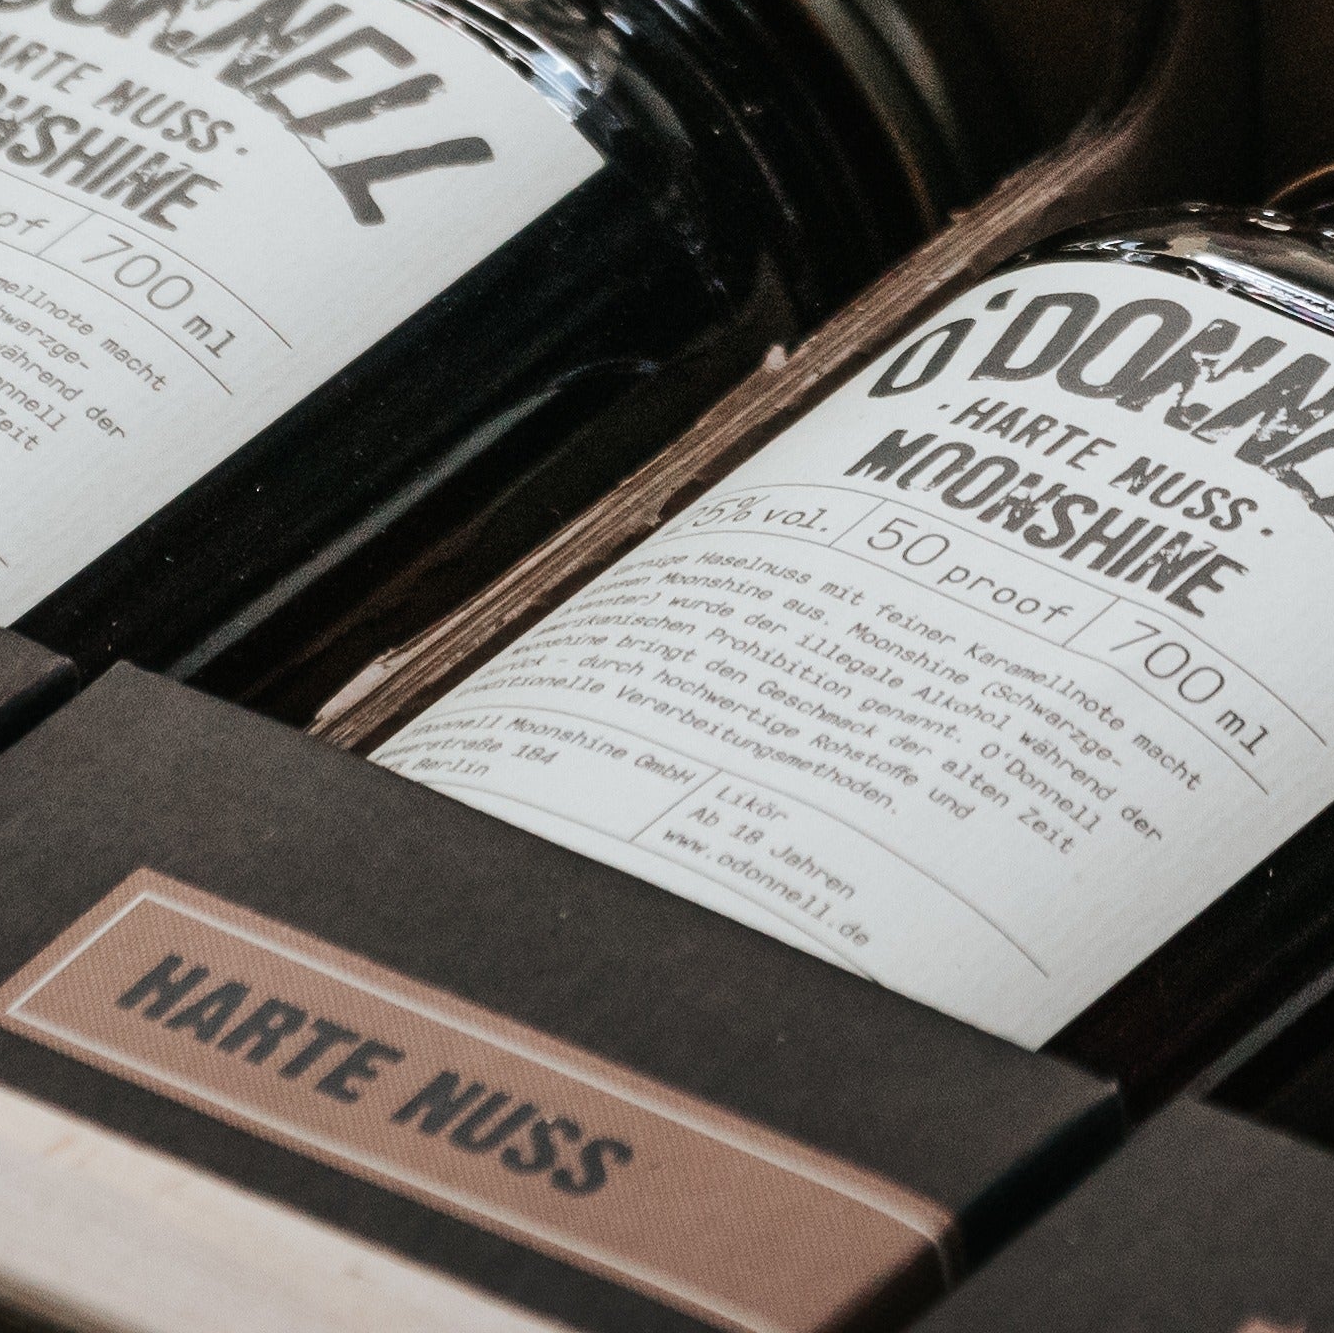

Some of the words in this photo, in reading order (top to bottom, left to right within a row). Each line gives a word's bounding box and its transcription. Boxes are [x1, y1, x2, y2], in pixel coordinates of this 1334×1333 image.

[91, 77, 236, 156] NUSS
[79, 231, 197, 313] 700
[180, 313, 238, 361] ml
[83, 404, 129, 440] der
[98, 335, 169, 394] macht
[761, 506, 829, 534] vol.
[841, 428, 1252, 621] MOONSHINE
[951, 395, 1116, 472] HARTE
[1110, 454, 1260, 534] NUSS
[864, 515, 953, 569] 50
[934, 563, 1076, 625] proof
[658, 571, 774, 602] Moonshine
[781, 596, 830, 627] aus.
[844, 620, 971, 687] Moonshine
[979, 679, 1124, 769] (Schwarzge-
[666, 595, 737, 619] wurde
[742, 612, 789, 635] der
[793, 632, 906, 691] illegale
[909, 684, 1013, 733] Alkohol
[1017, 729, 1119, 803] während
[1118, 804, 1165, 842] der
[694, 551, 814, 588] Haselnuss
[817, 580, 866, 608] mit
[874, 602, 958, 646] feiner
[962, 640, 1127, 733] Karamellnote
[1130, 731, 1203, 793] macht
[703, 625, 854, 701] Prohibition
[856, 696, 962, 745] genannt.
[978, 741, 1103, 835] O'Donnell
[1108, 618, 1228, 707] 700
[1213, 707, 1272, 759] ml
[503, 715, 630, 761] Moonshine
[631, 752, 700, 787] GmbH
[509, 742, 561, 766] 184
[576, 652, 646, 678] durch
[651, 666, 802, 739] hochwertige
[807, 731, 921, 788] Rohstoffe
[926, 785, 978, 822] und
[614, 632, 698, 664] bringt
[703, 657, 750, 686] den
[755, 678, 880, 740] Geschmack
[886, 733, 934, 757] der
[939, 757, 1012, 809] alten
[1015, 804, 1076, 856] Zeit
[614, 683, 898, 816] Verarbeitungsmethoden.
[685, 804, 722, 828] Ab
[727, 822, 767, 846] 18
[768, 844, 857, 902] Jahren
[714, 784, 790, 822] Likör
[661, 827, 872, 948] www.odonnell.de
[113, 950, 409, 1110] HARTE
[391, 1067, 635, 1199] NUSS
